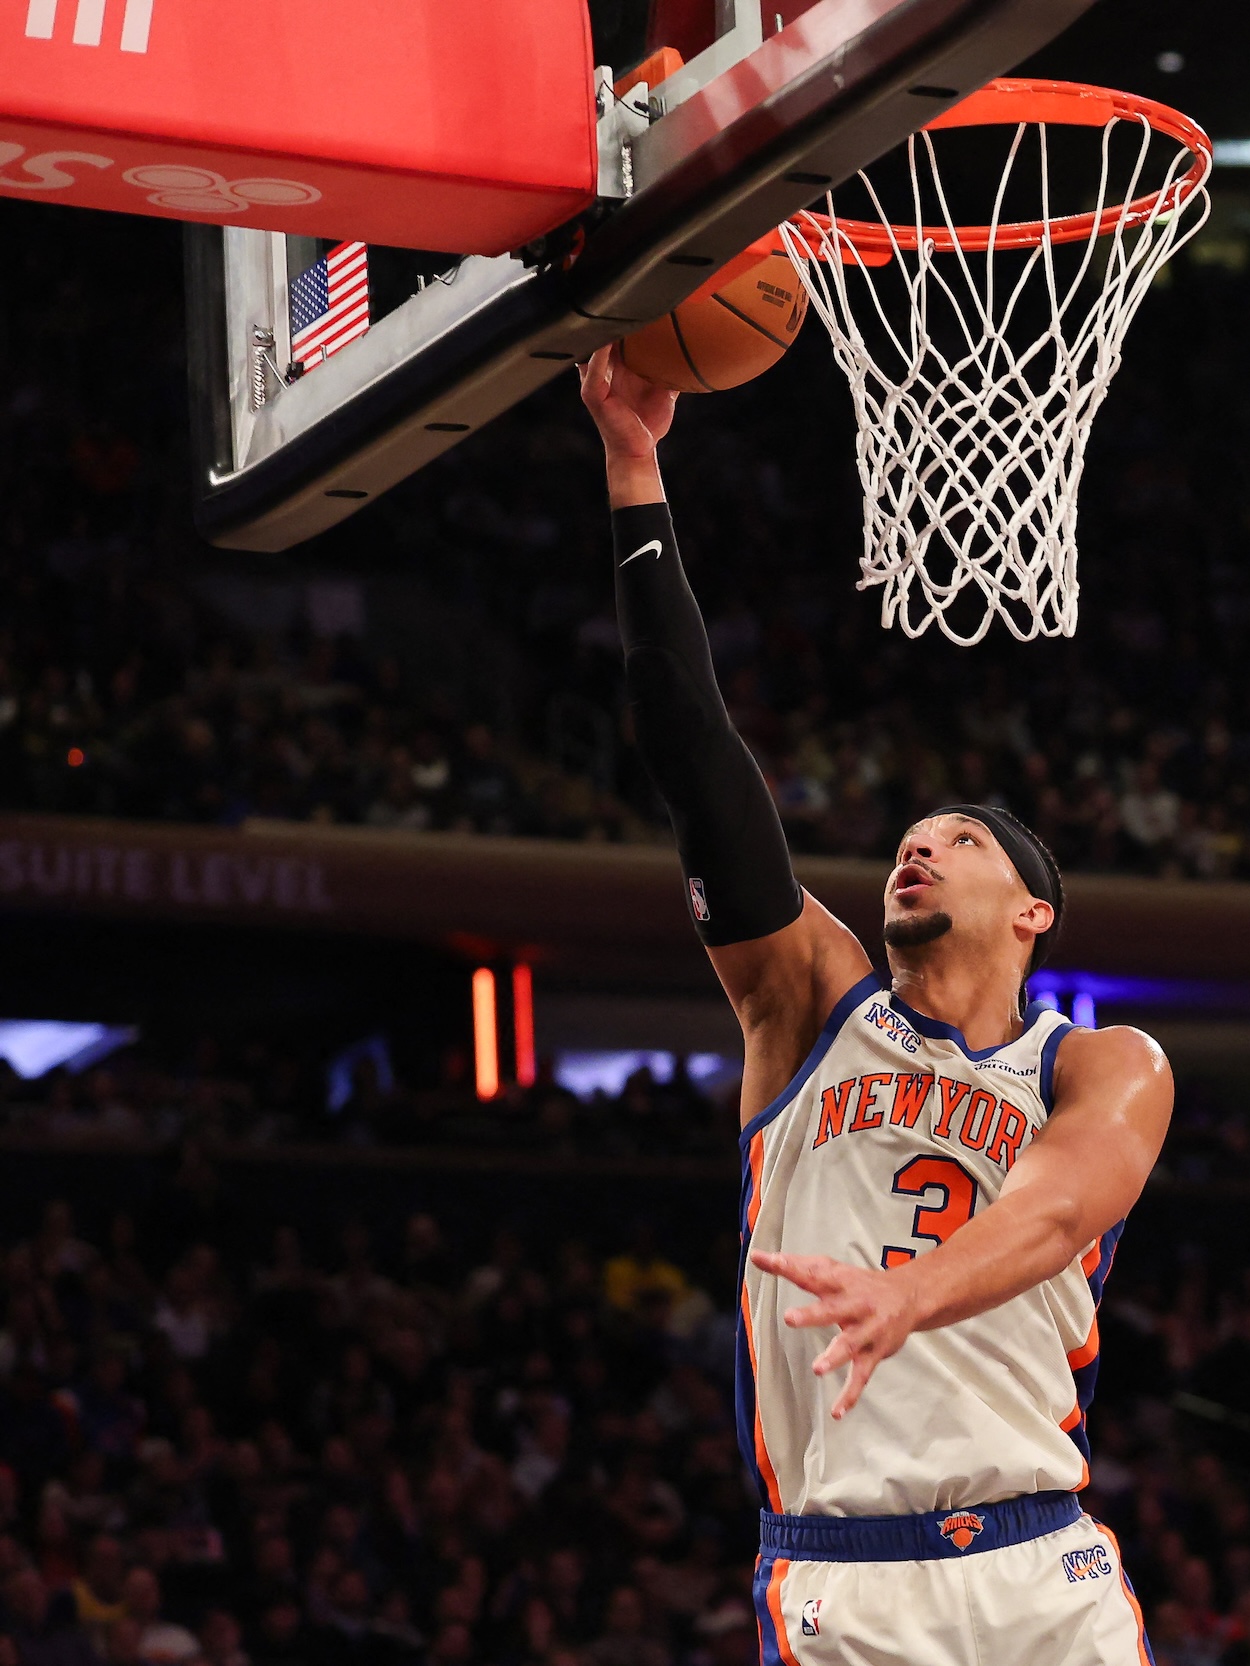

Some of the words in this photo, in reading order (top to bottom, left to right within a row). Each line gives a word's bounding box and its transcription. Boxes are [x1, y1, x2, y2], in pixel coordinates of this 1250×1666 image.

[0, 842, 150, 898] SUITE
[169, 852, 332, 910] LEVEL
[864, 1002, 921, 1053] NYC
[813, 1072, 935, 1150] NEW
[933, 1076, 1040, 1173] YOR
[941, 1514, 983, 1535] KNICKS
[1062, 1544, 1112, 1582] NYC
